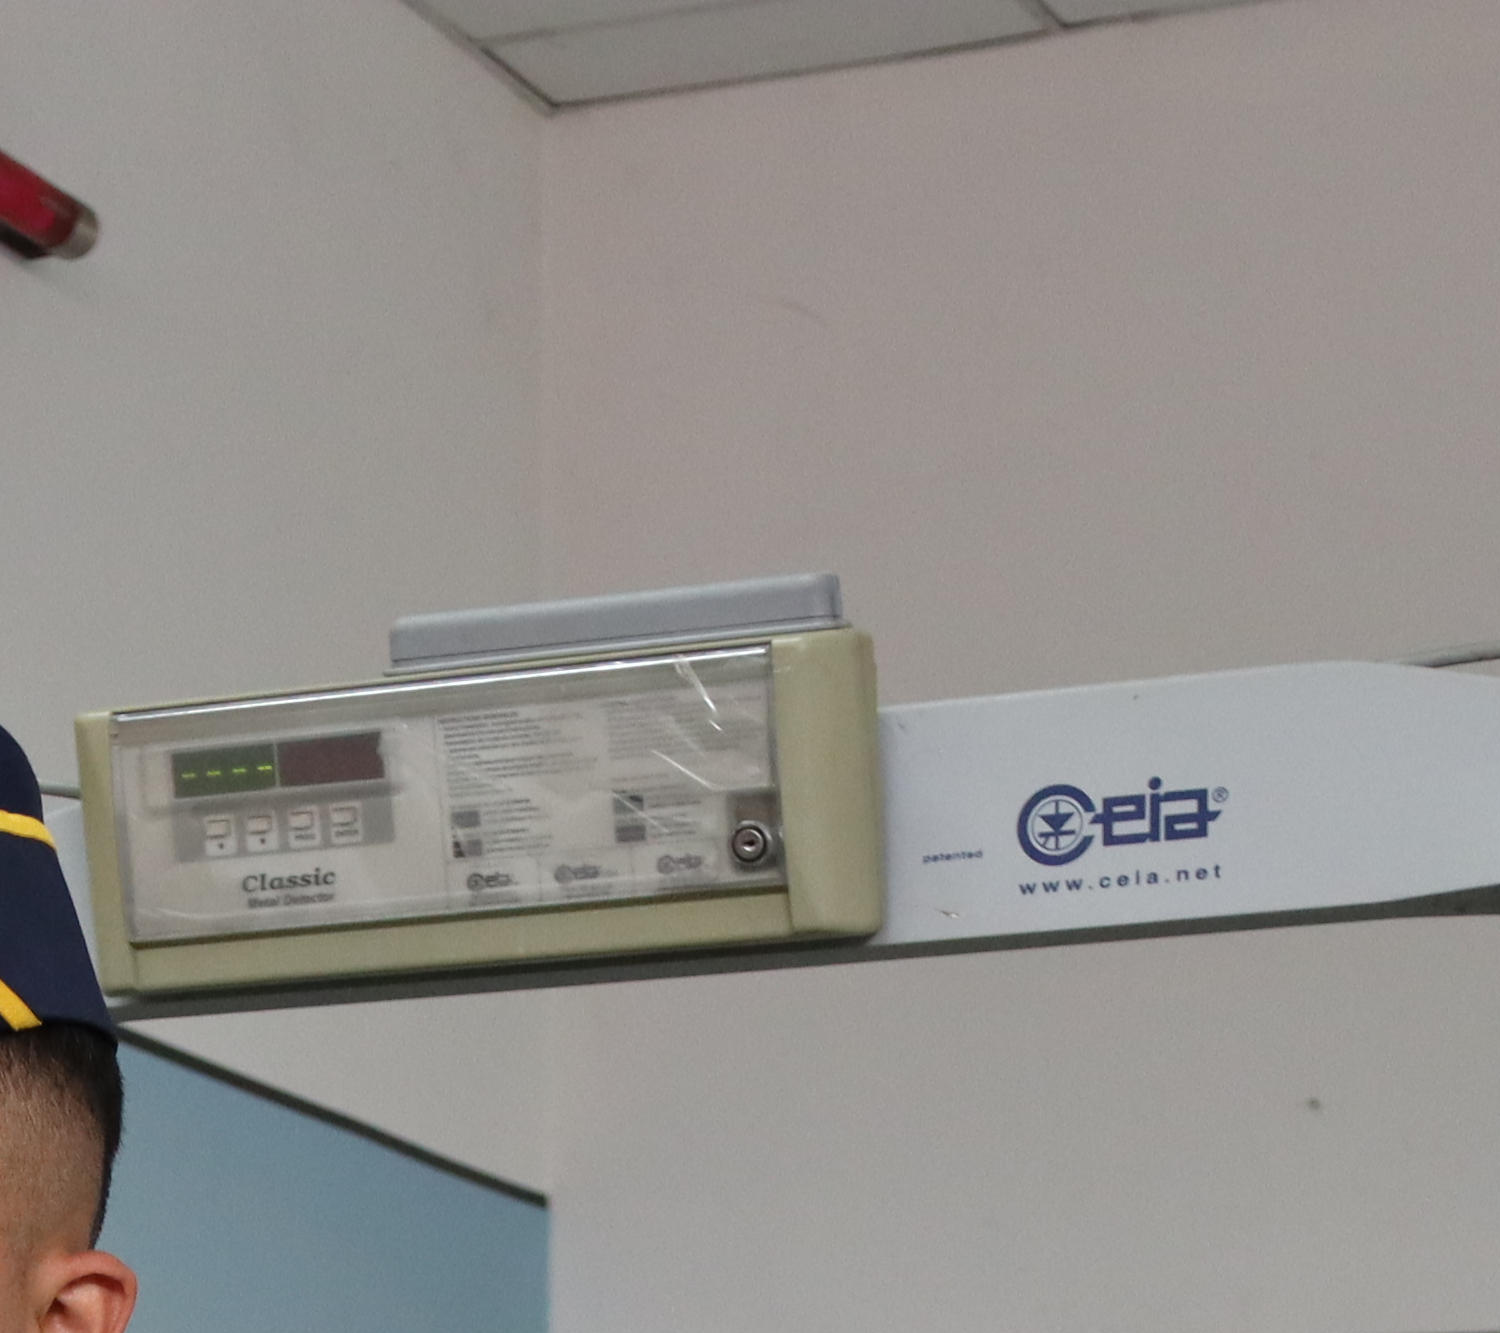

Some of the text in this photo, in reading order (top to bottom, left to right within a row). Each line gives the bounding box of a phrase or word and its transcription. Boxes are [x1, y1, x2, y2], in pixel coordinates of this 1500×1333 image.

[923, 850, 983, 863] patented
[242, 867, 336, 893] Classic
[1020, 865, 1222, 894] www.ceia.net
